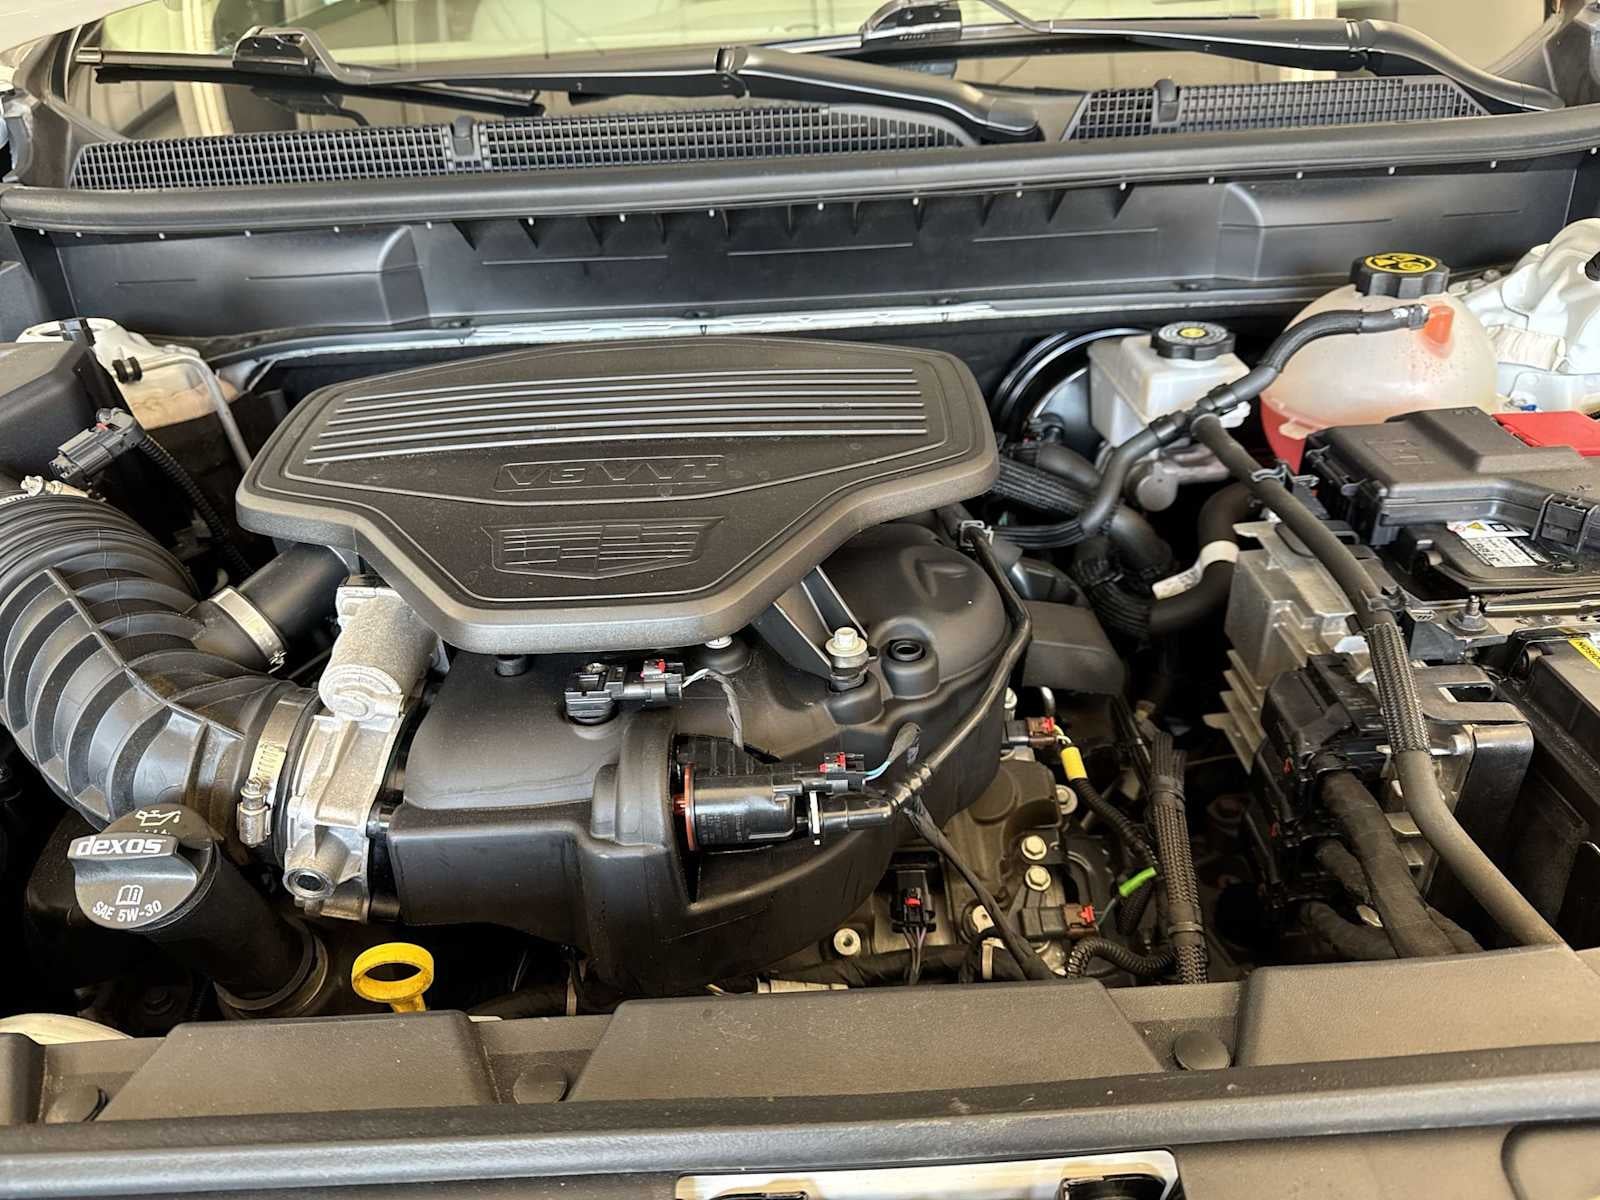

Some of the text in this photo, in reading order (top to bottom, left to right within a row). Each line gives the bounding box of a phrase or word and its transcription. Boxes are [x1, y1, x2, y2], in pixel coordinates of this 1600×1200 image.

[505, 462, 719, 486] V6 VVT
[76, 836, 162, 856] dexos
[92, 900, 162, 922] SAE 5W-30
